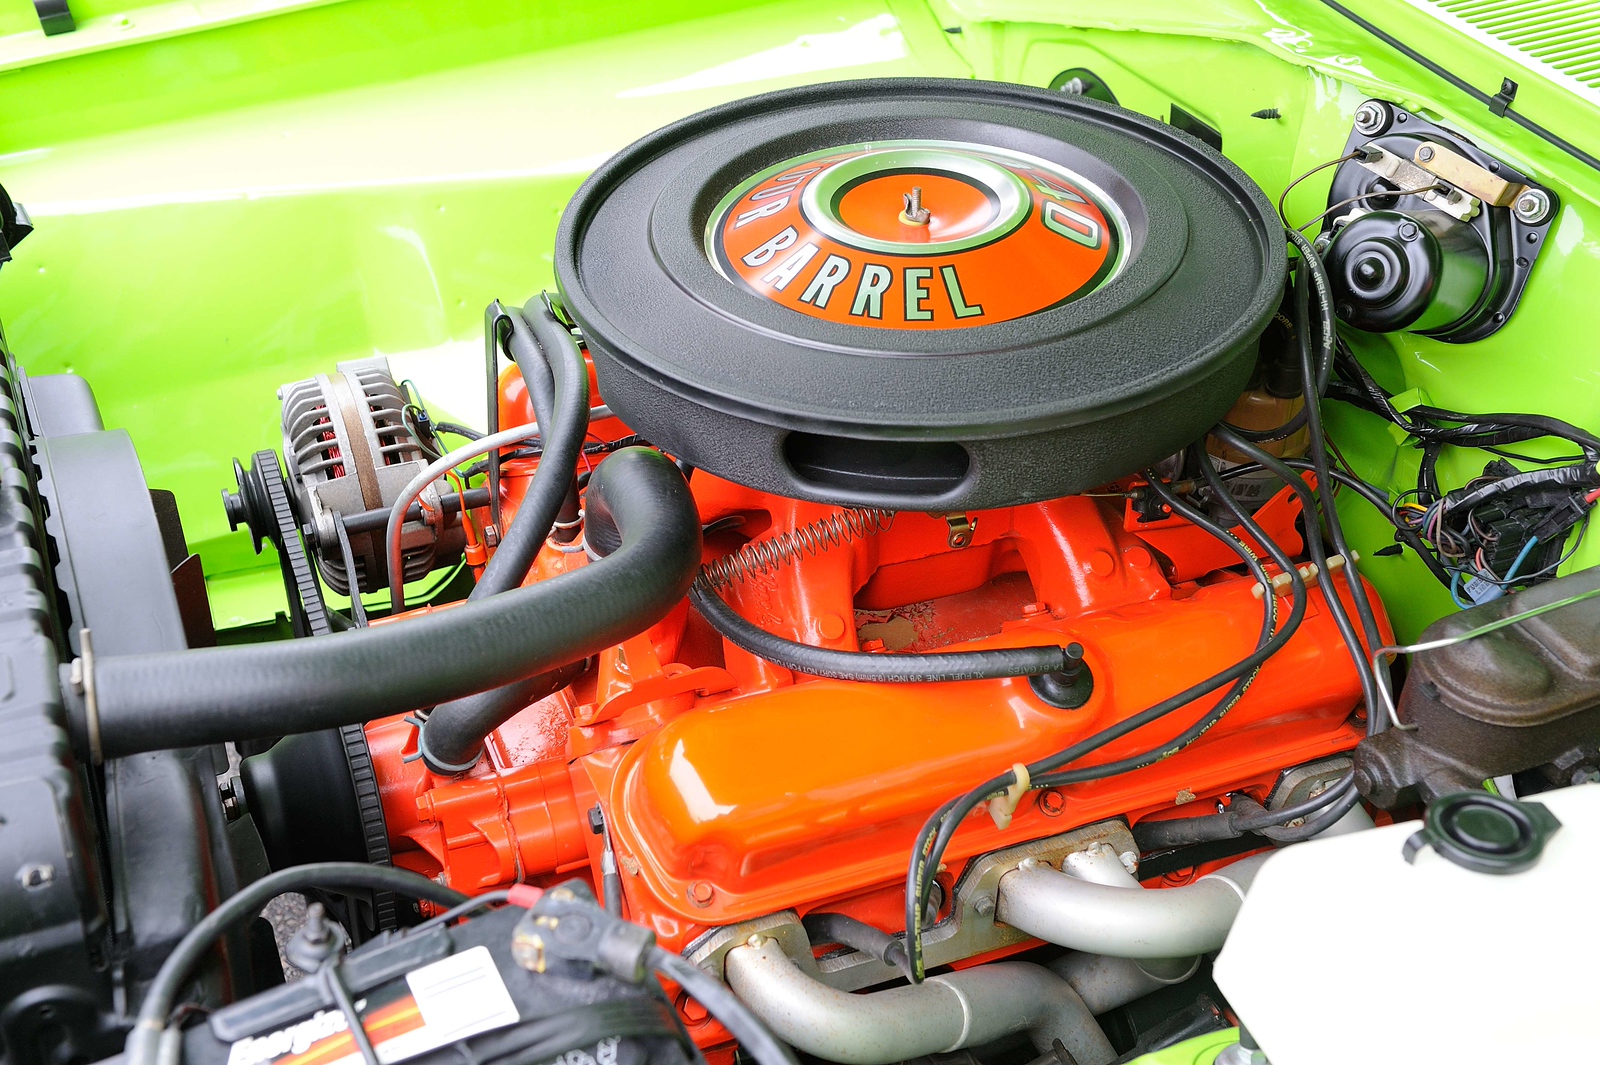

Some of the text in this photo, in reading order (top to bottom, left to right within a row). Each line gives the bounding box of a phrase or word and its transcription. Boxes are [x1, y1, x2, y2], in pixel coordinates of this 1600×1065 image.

[733, 158, 984, 322] OUR BARREL
[1301, 243, 1317, 270] SUPER
[1313, 272, 1329, 312] HI-TEMP
[1239, 539, 1258, 562] WIRE
[786, 662, 802, 672] FOR
[803, 666, 818, 675] NOT
[1008, 665, 1037, 675] GATES
[838, 671, 854, 680] SAE
[887, 674, 909, 683] INCH
[910, 674, 923, 682] 3/8
[926, 674, 946, 682] LINE
[950, 672, 972, 681] FUEL
[1242, 665, 1261, 694] STOCK
[922, 827, 937, 857] STOCK
[915, 860, 925, 898] SUPER
[914, 902, 923, 952] HI-TEMP
